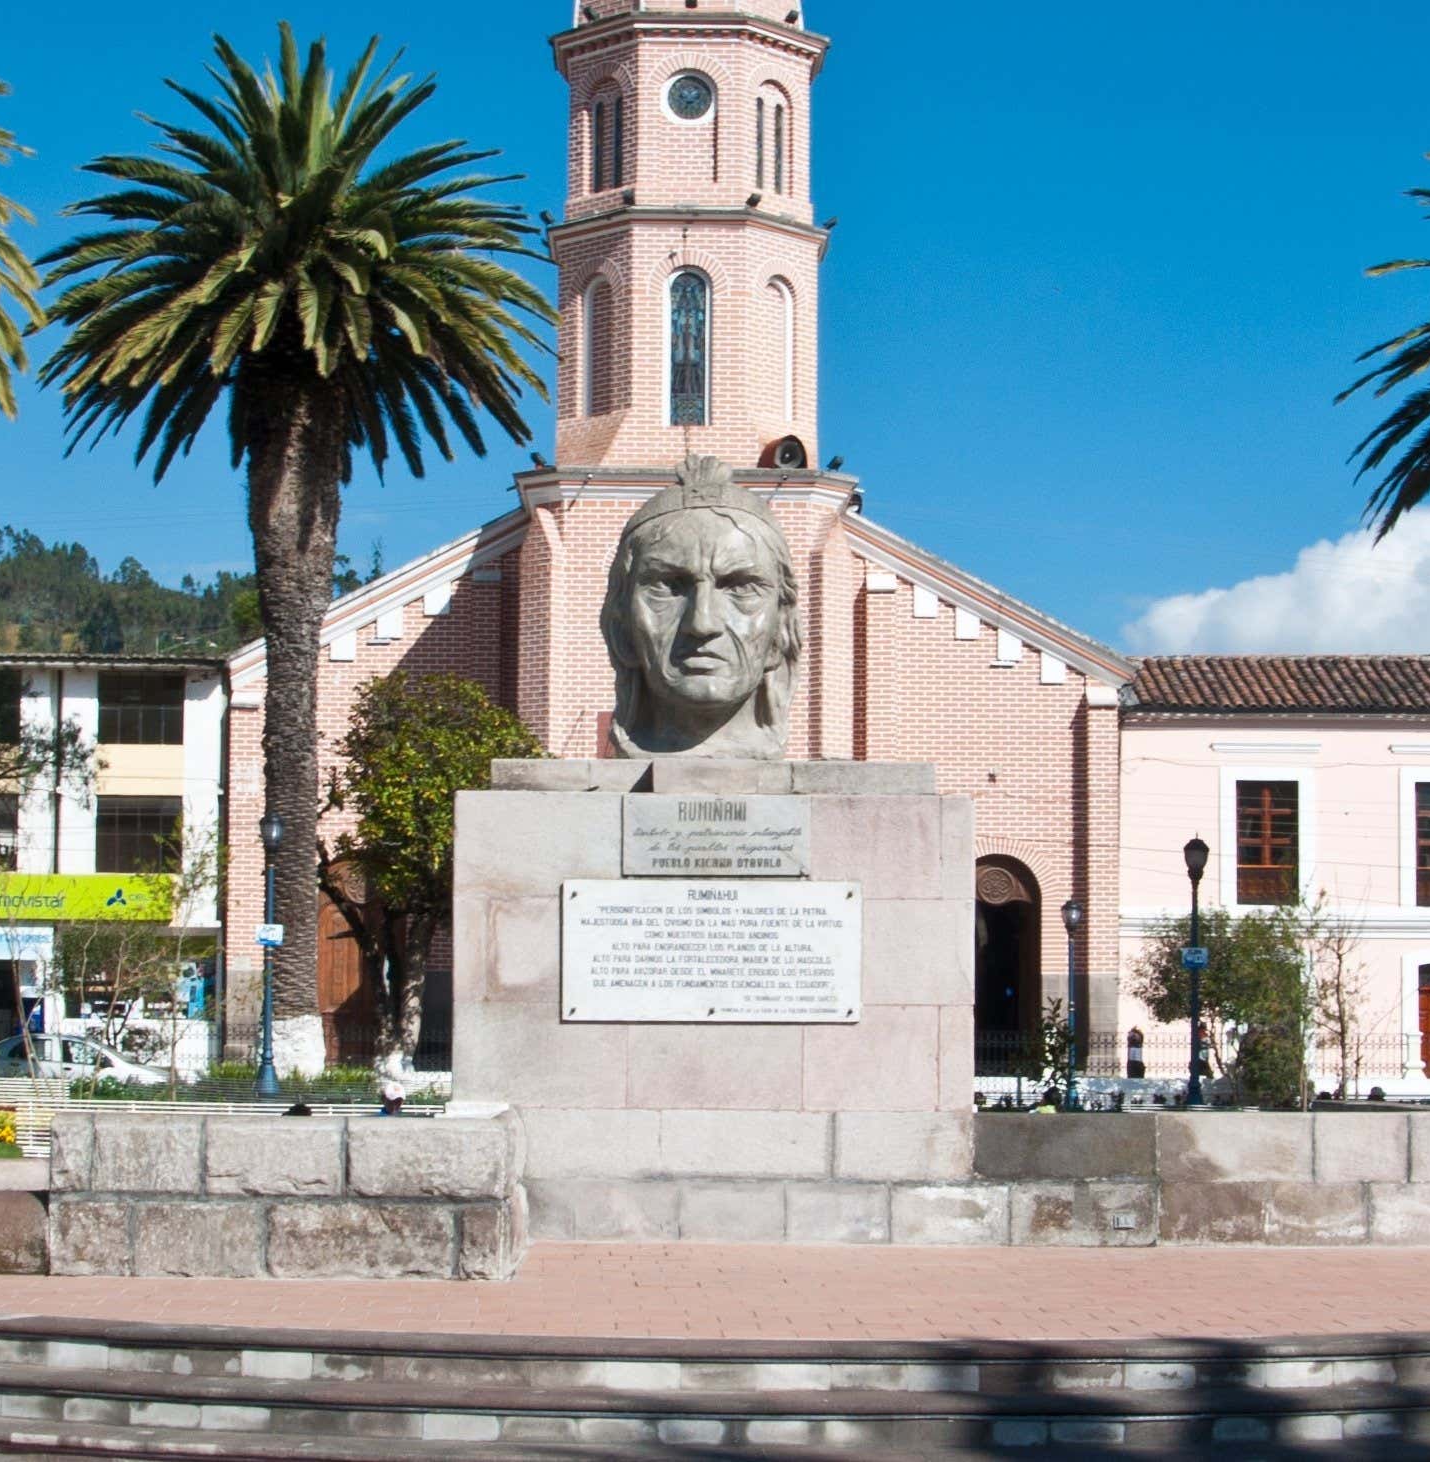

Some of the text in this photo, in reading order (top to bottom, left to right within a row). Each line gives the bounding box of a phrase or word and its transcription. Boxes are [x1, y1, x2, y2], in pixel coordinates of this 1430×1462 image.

[678, 798, 747, 822] RUMIÑAWI
[651, 858, 690, 868] PUEBLO
[736, 858, 782, 868] OTAVALO
[687, 887, 739, 901] RUMIÑAHUI
[665, 906, 675, 914] DE
[678, 907, 693, 915] LOS
[742, 907, 773, 915] VALORES
[777, 907, 786, 915] DE
[789, 907, 799, 915] LA
[646, 918, 659, 926] DEL
[707, 919, 717, 927] LA
[792, 919, 801, 927] DE
[805, 919, 815, 927] LA
[644, 931, 664, 939] COMO
[667, 931, 704, 939] NUESTROS
[611, 943, 630, 951] ALTO
[633, 943, 651, 951] PARA
[593, 955, 610, 963] ALTO
[613, 955, 631, 963] PARA
[667, 955, 675, 963] LA
[591, 968, 609, 976] ALTO
[611, 968, 629, 976] PARA
